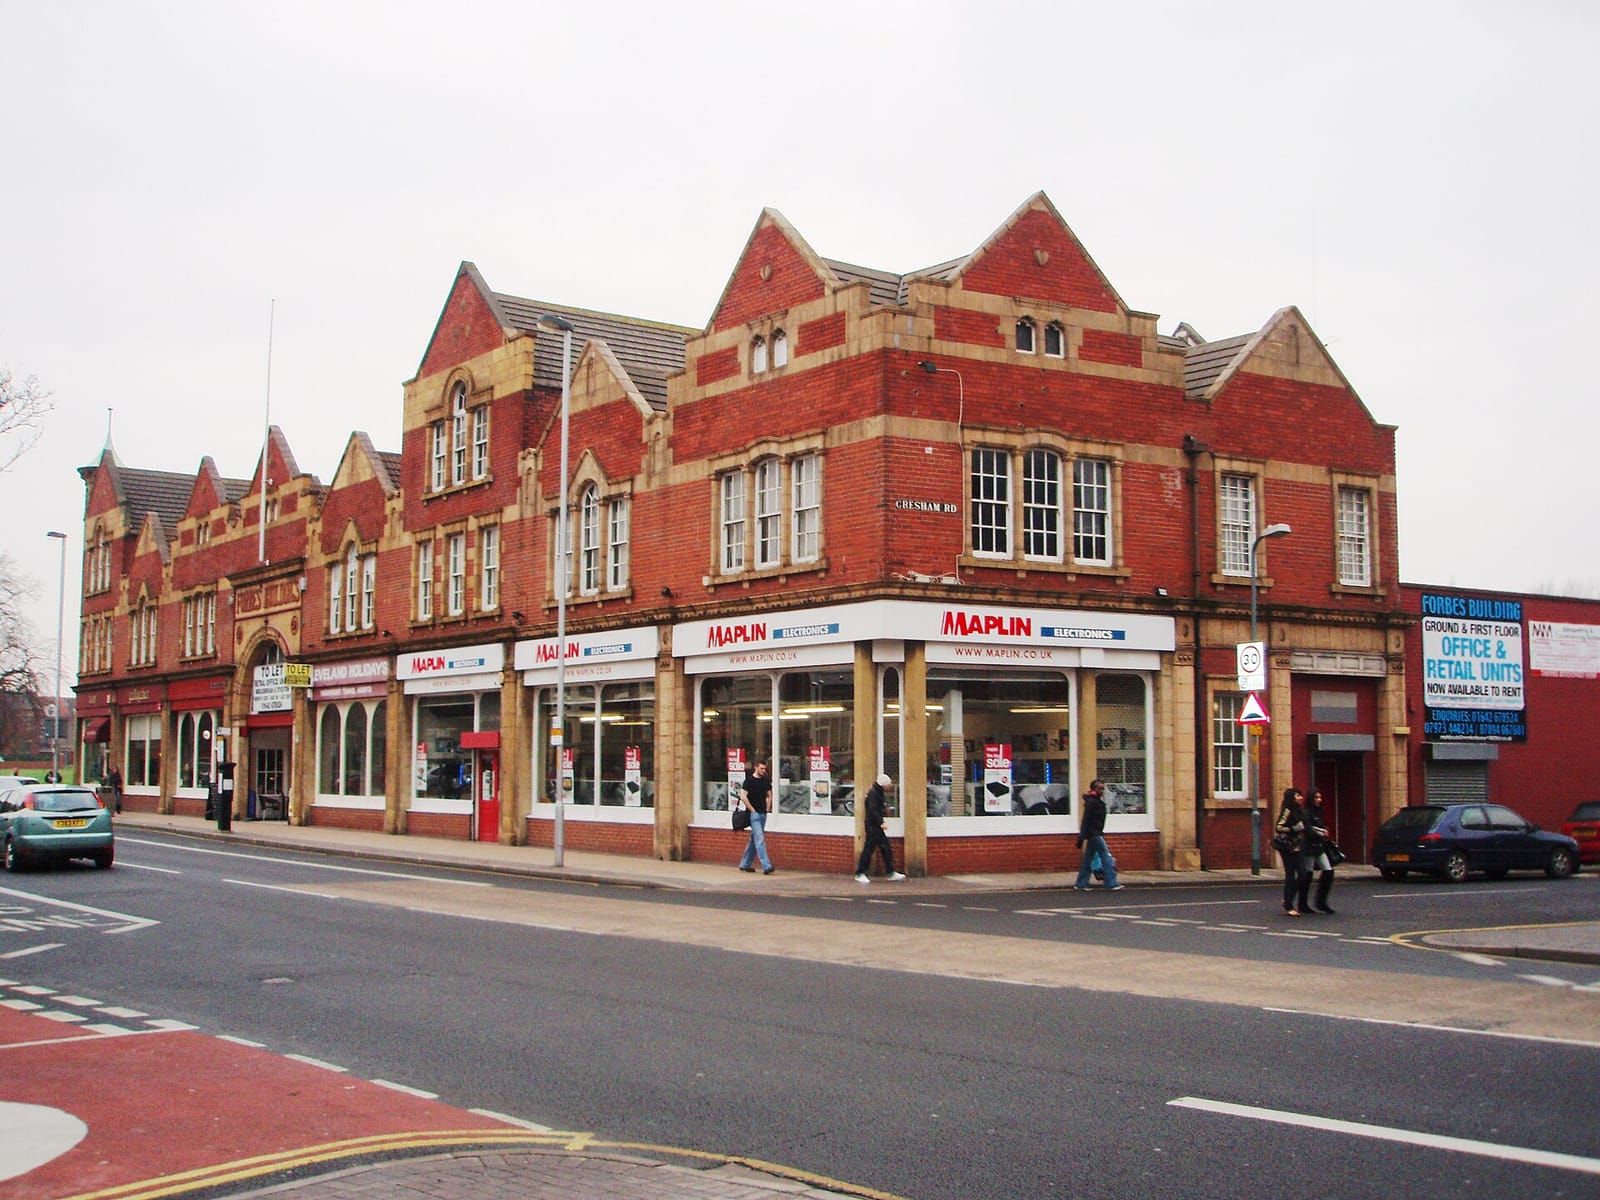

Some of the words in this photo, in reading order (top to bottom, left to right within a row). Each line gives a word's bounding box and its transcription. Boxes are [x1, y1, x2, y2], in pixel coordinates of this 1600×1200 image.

[944, 503, 957, 513] RD
[1422, 595, 1467, 617] FORBES
[1469, 598, 1521, 620] BUILDING
[941, 611, 1031, 637] MAPLIN
[1054, 627, 1113, 640] ELECTRONICS
[1424, 620, 1459, 634] GROUND
[1461, 623, 1468, 634] &
[1470, 623, 1492, 636] FIRST
[1494, 625, 1519, 638] FLOOR
[707, 622, 767, 648] MAPLIN
[782, 625, 829, 638] ELECTRONICS
[590, 645, 625, 656] ELECTRONICS
[955, 647, 1053, 660] WWW.MAPLIN.CO.UK
[1441, 636, 1492, 658] OFFICE
[1496, 640, 1507, 659] &
[411, 655, 446, 674] MAPLIN
[1243, 653, 1258, 665] 30
[261, 666, 270, 678] TO
[271, 664, 284, 677] LET
[286, 664, 296, 674] TO
[297, 665, 310, 674] LET
[313, 664, 347, 682] EVELAND
[348, 660, 389, 678] HOLIDAYS
[1426, 658, 1476, 680] RETAIL
[1480, 662, 1522, 683] UNITS
[1427, 683, 1446, 694] NOW
[1447, 684, 1489, 696] AVAILABLE
[1491, 686, 1500, 697] TO
[1501, 686, 1521, 697] RENT
